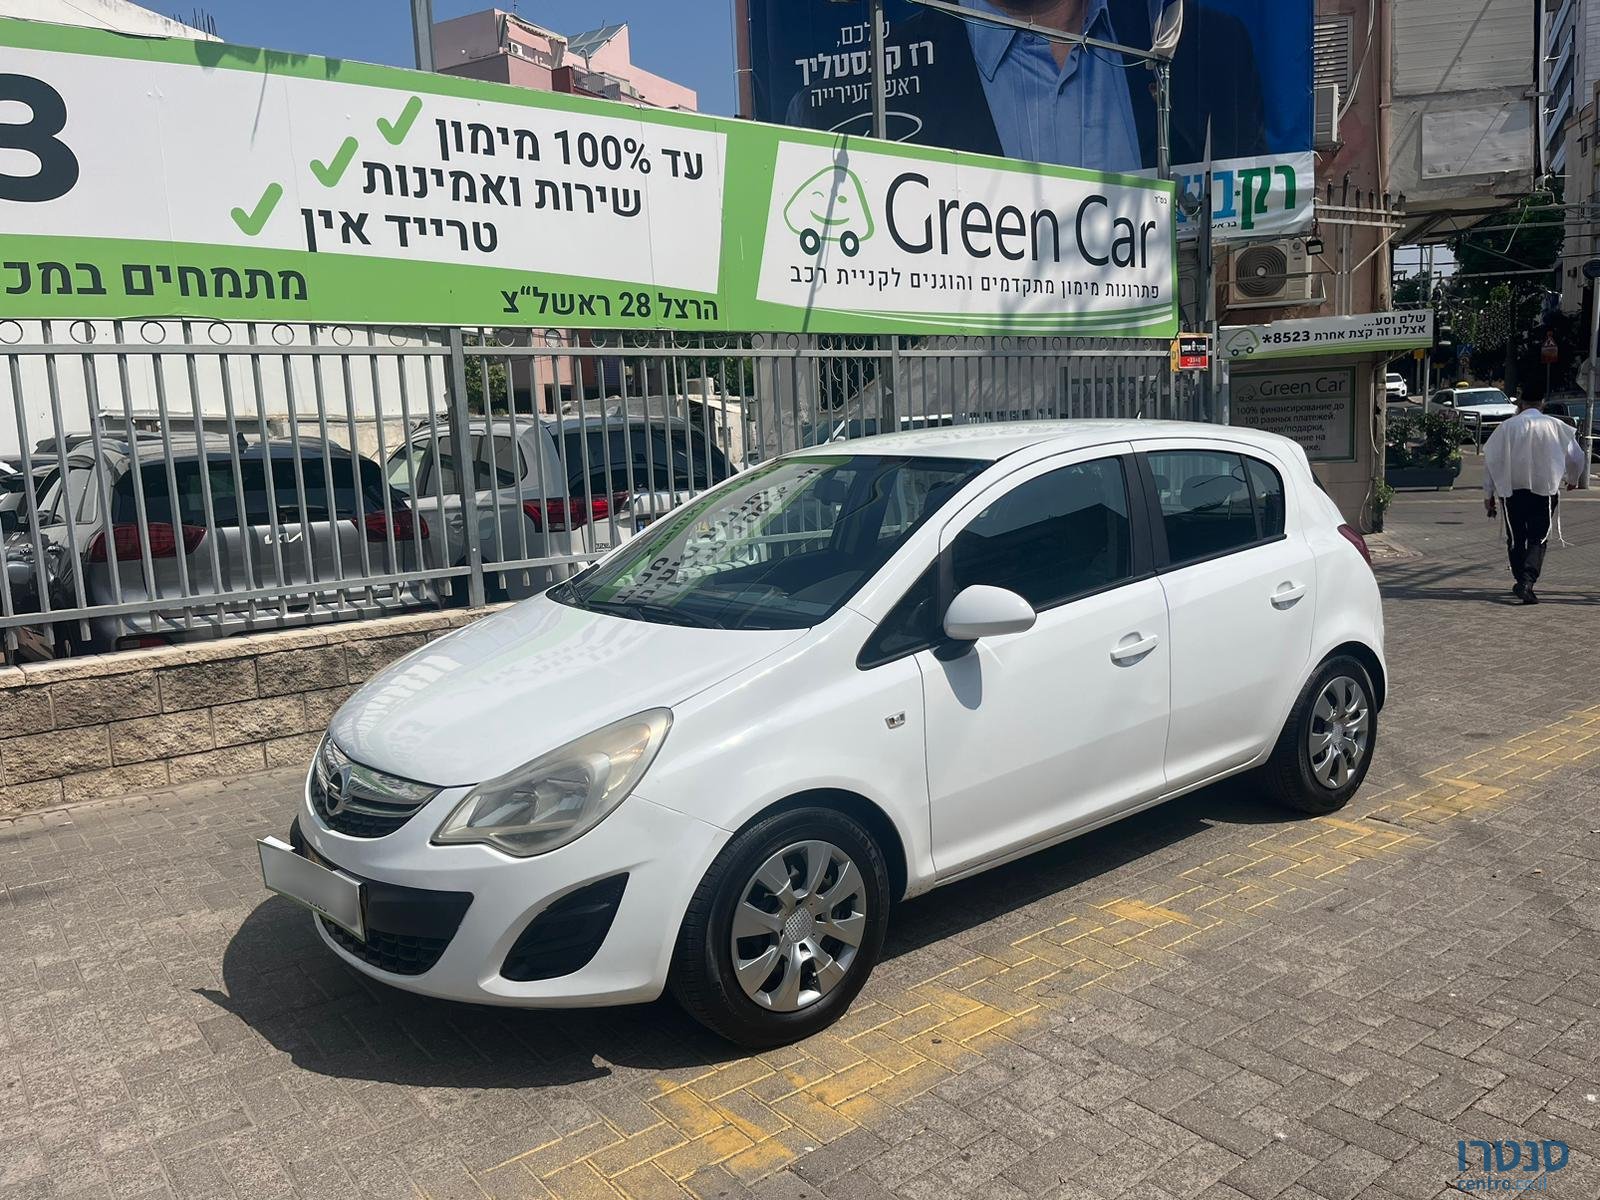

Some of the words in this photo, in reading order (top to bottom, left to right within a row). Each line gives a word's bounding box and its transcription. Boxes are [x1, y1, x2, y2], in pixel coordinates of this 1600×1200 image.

[909, 40, 934, 67] רז
[795, 45, 902, 86] קסטליך
[884, 76, 920, 98] ראש
[435, 118, 540, 161] מימון
[554, 130, 652, 174] 100%
[661, 148, 704, 180] עד
[362, 161, 520, 206] ואמינות
[535, 179, 642, 217] שירות
[300, 207, 372, 252] אין
[885, 172, 1060, 262] Green
[1075, 194, 1156, 268] Car
[385, 214, 498, 253] טרייד
[121, 264, 308, 300] מתמחים
[790, 265, 827, 284] רכב
[837, 267, 901, 291] לקניית
[910, 272, 972, 291] והוגנים
[981, 276, 1055, 297] מתקדמים
[1061, 280, 1099, 298] מימון
[1105, 283, 1159, 298] פתרונות
[618, 291, 652, 318] 28
[657, 292, 718, 320] הרצל
[1392, 324, 1426, 336] אצלנו
[1399, 313, 1426, 325] שלם
[1314, 332, 1346, 342] אחרת
[1349, 327, 1373, 340] קצת
[1376, 328, 1390, 337] זה
[1259, 380, 1311, 396] Green
[1315, 377, 1346, 393] Car
[1236, 405, 1258, 416] 100%
[1334, 402, 1345, 412] до
[1245, 415, 1259, 425] 100
